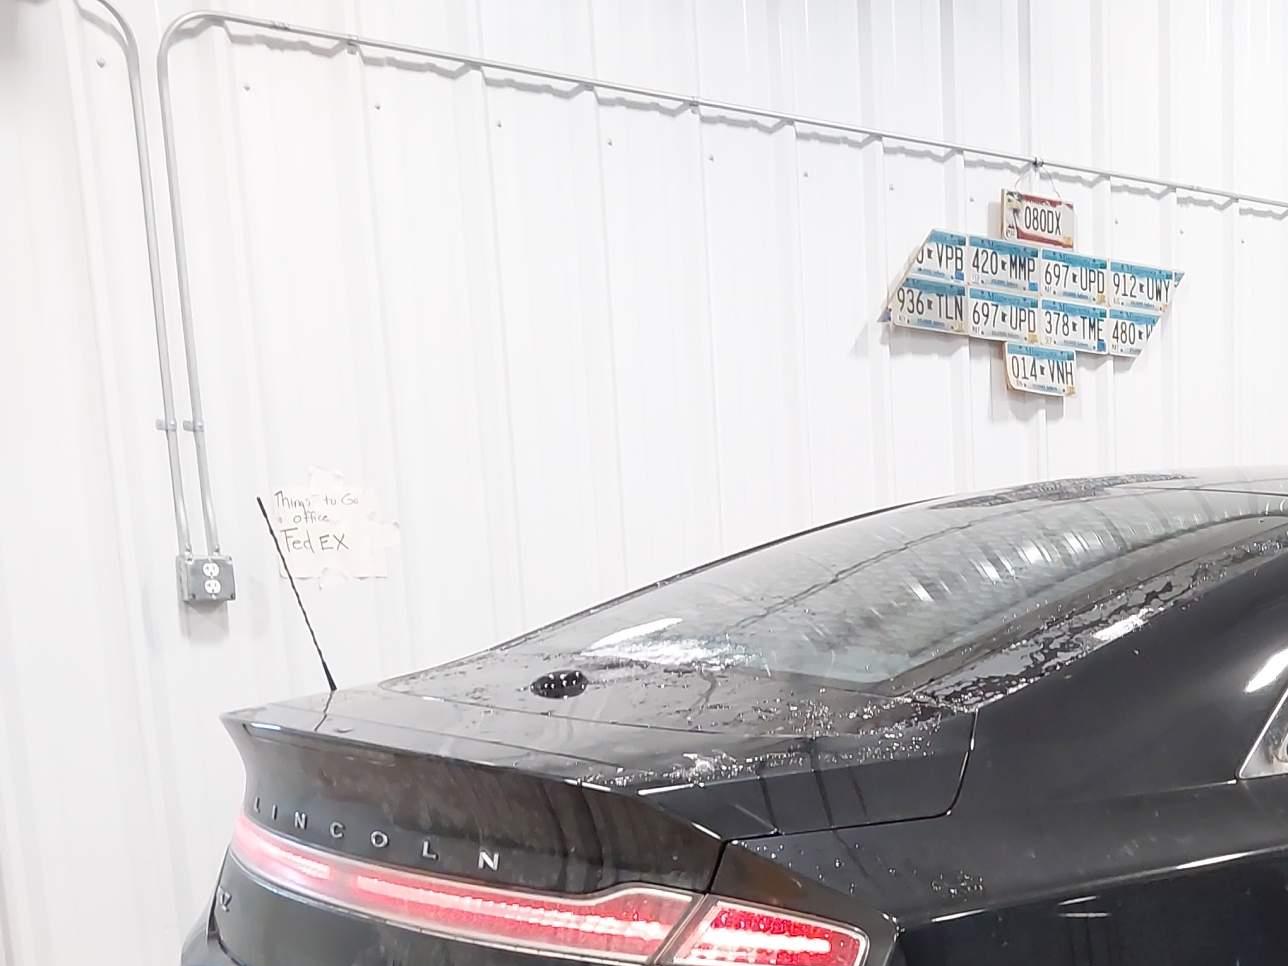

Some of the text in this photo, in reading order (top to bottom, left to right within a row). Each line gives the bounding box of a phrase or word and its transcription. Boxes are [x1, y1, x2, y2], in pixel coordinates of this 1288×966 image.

[936, 243, 965, 273] VPB
[972, 248, 999, 275] 420
[1009, 254, 1036, 281] MMP
[1044, 263, 1070, 289] 697
[1080, 267, 1105, 294] UPD
[1113, 272, 1170, 303] 912 UWY
[897, 287, 926, 316] 936
[936, 293, 964, 322] TLN
[972, 302, 1000, 329] 697
[1010, 305, 1036, 333] UPD
[1045, 311, 1105, 342] 378 TME
[1112, 320, 1136, 345] 480
[1011, 355, 1074, 386] 014 VNH
[254, 796, 501, 872] LINCOLN
